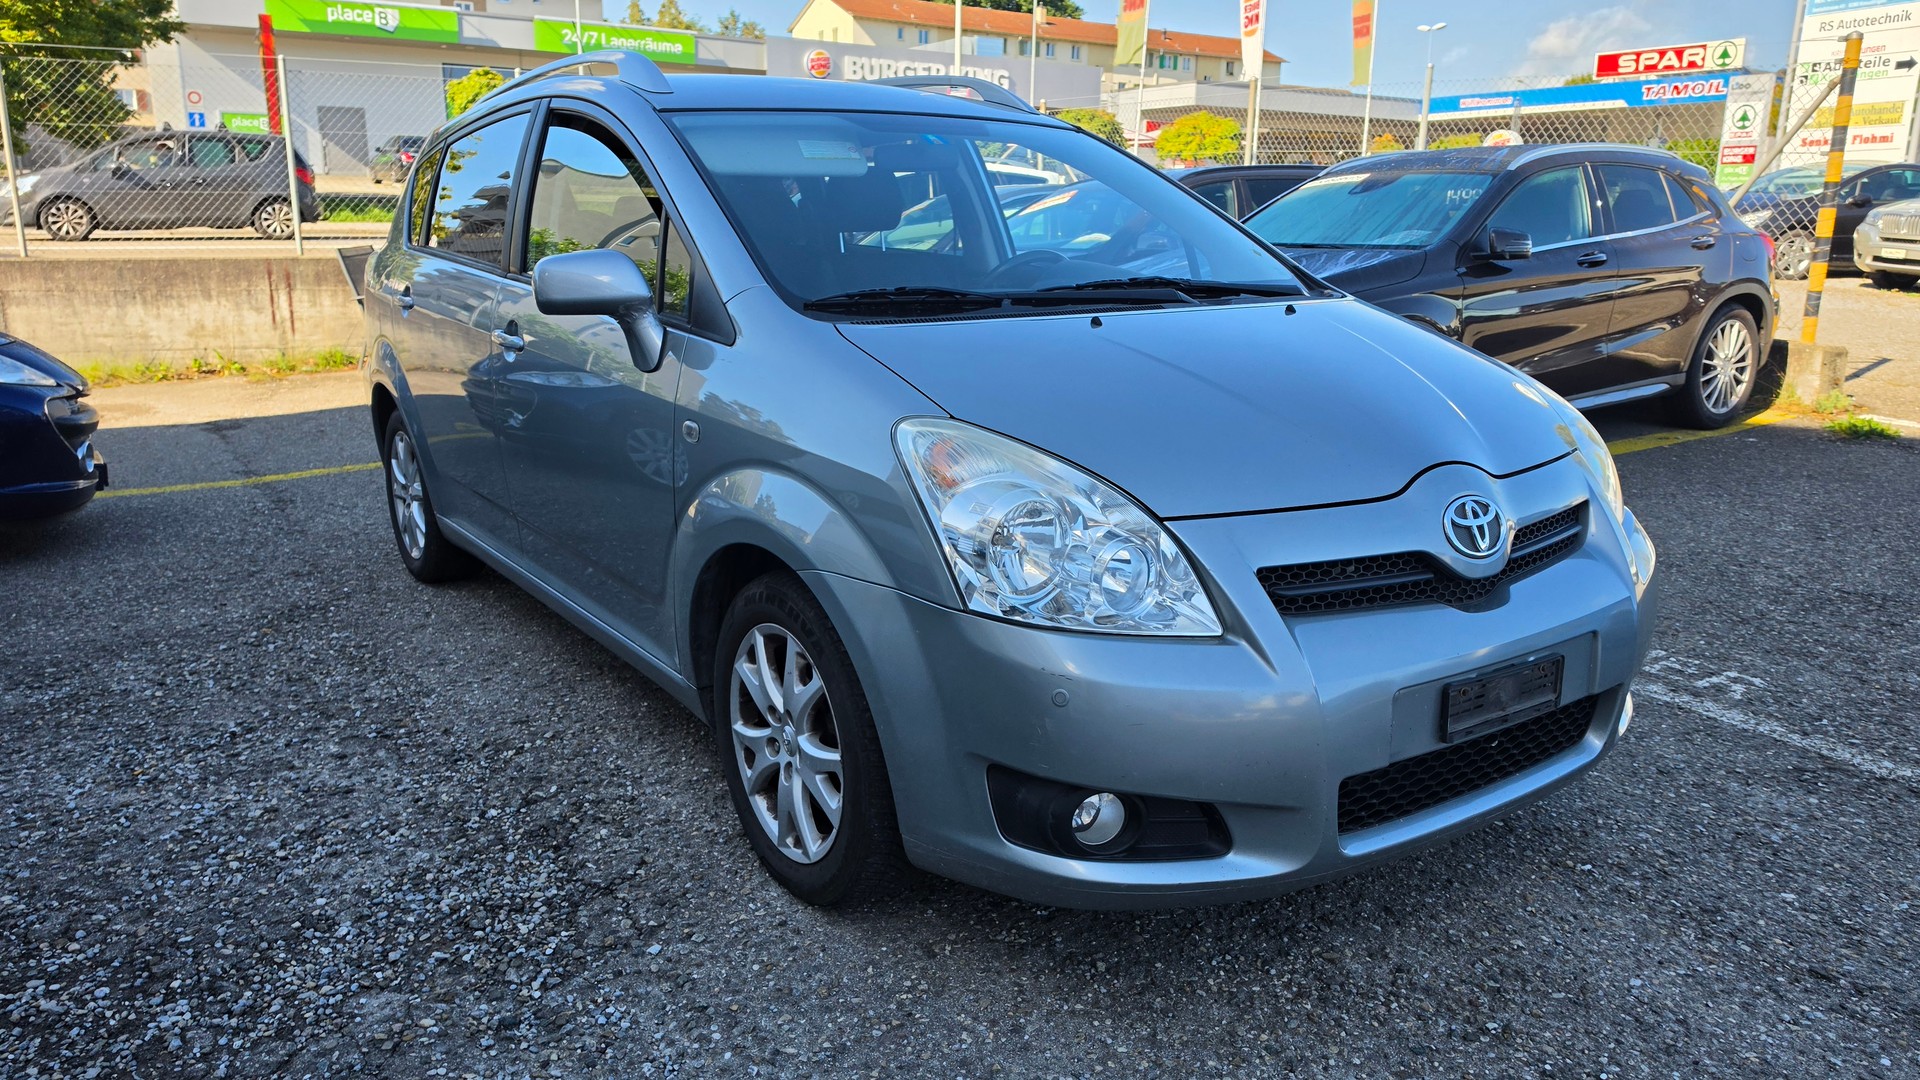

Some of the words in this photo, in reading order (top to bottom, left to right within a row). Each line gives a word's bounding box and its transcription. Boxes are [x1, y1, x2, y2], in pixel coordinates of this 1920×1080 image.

[1819, 21, 1834, 32] RS
[1836, 10, 1912, 30] Autotechnik
[1617, 48, 1706, 73] SPAR
[1642, 80, 1727, 99] TAMOIL
[1851, 133, 1895, 145] Flohmi
